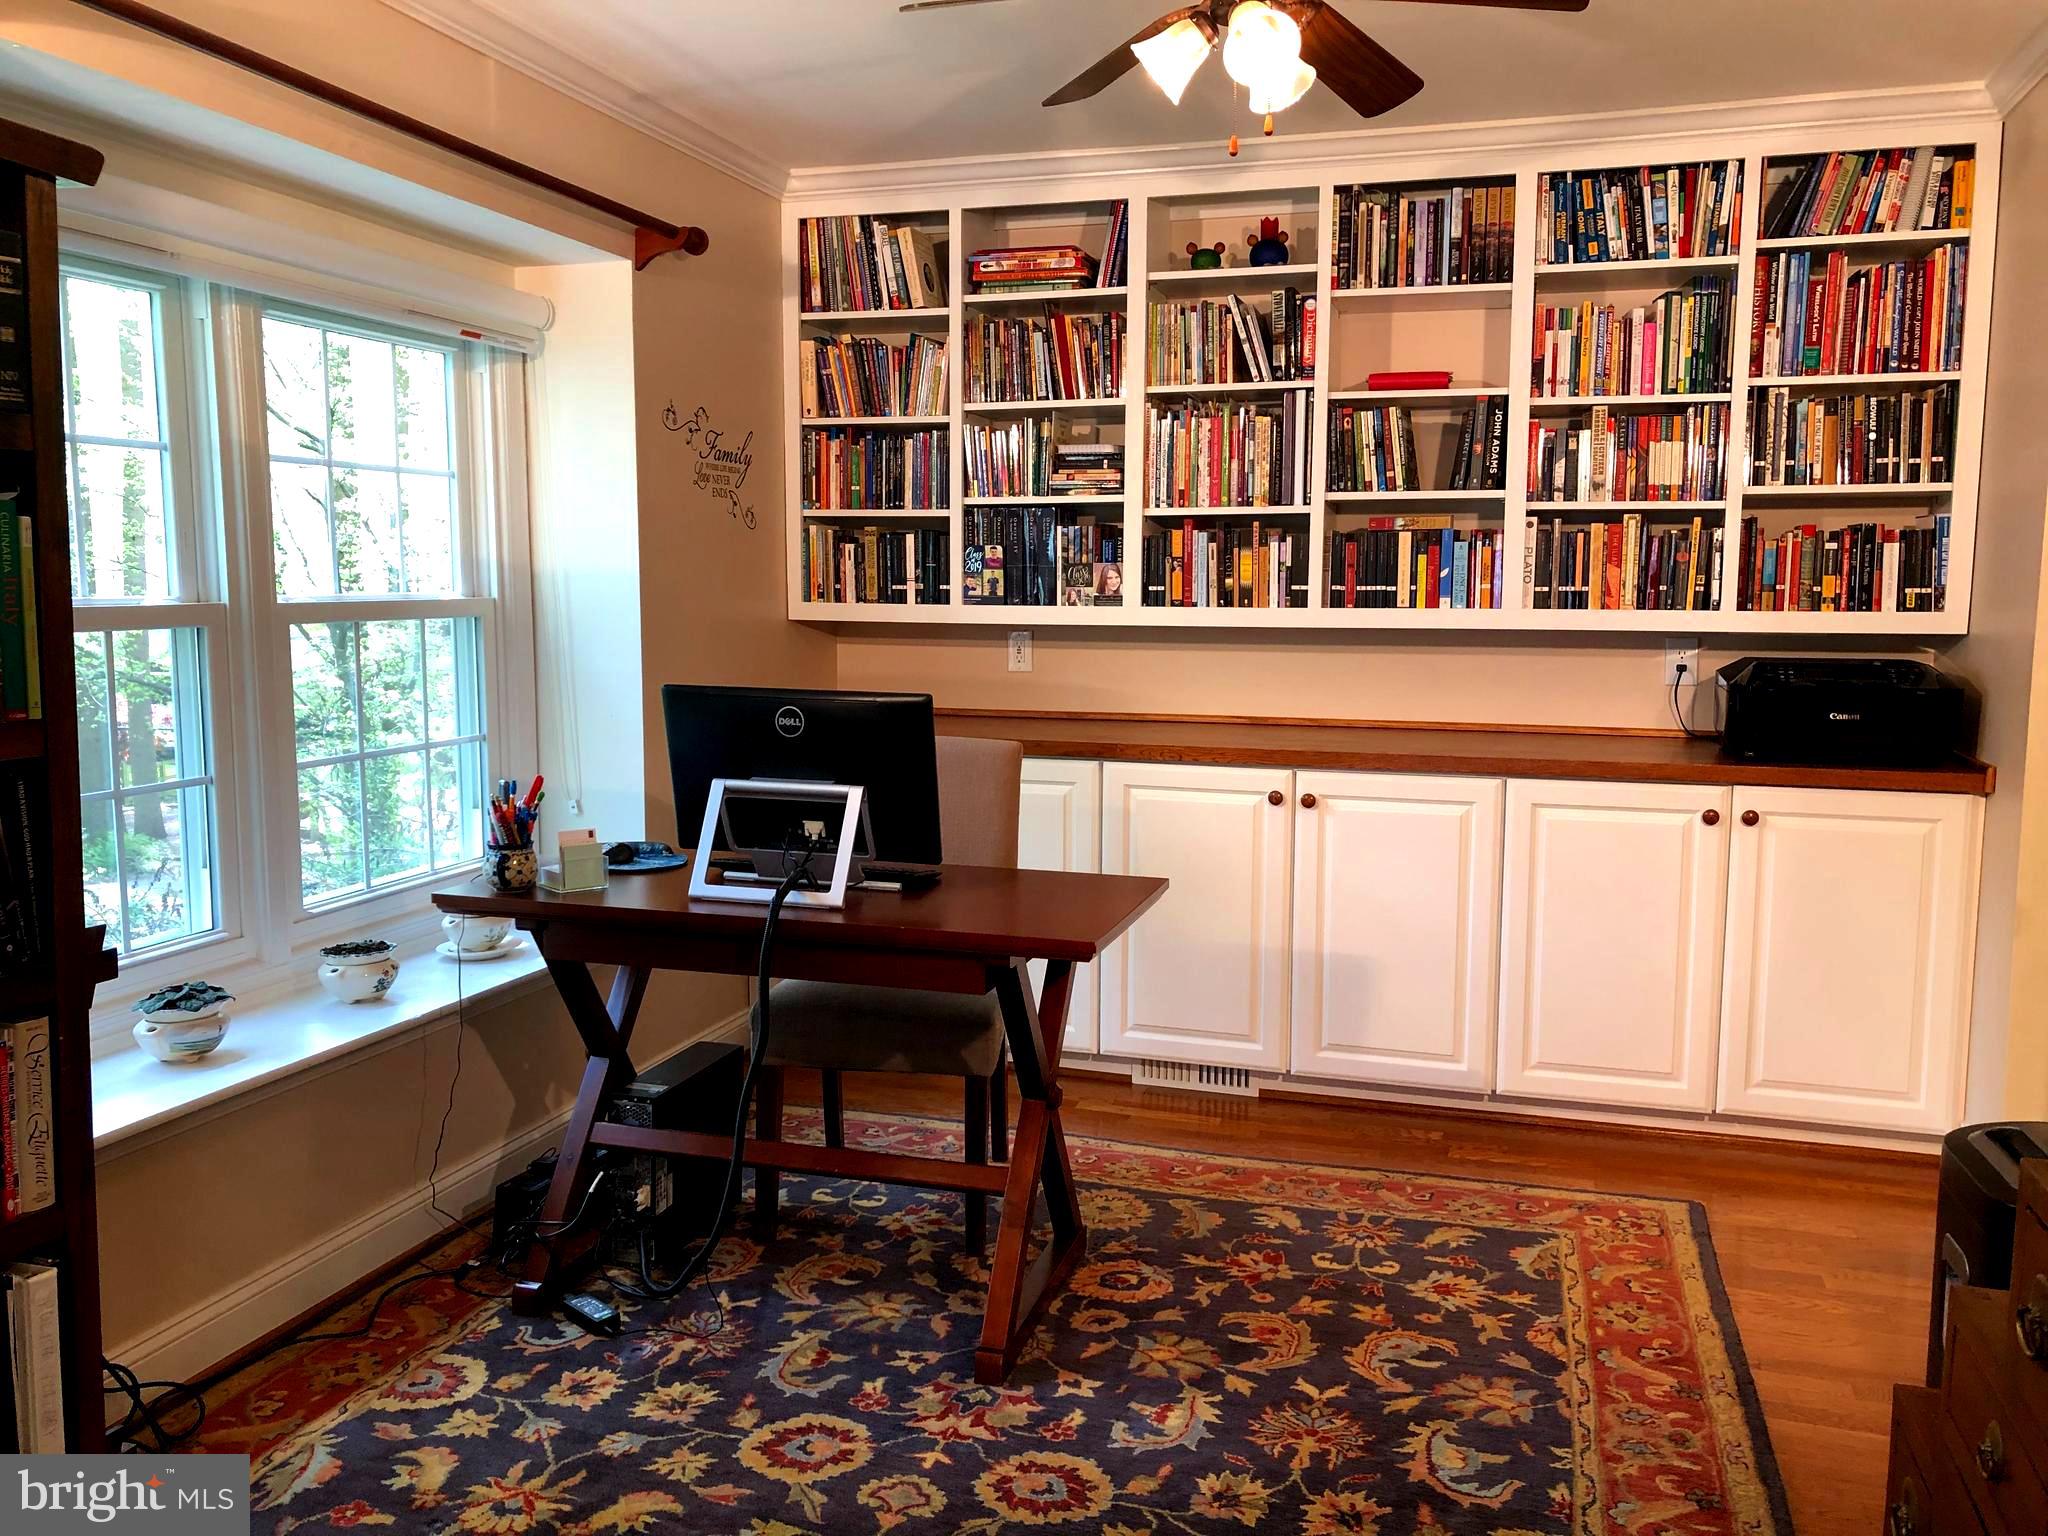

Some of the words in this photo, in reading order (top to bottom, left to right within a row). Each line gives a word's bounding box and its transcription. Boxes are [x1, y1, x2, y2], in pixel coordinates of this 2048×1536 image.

[1577, 211, 1585, 234] ROME
[1596, 211, 1606, 236] ITALY
[1634, 205, 1642, 226] ITALY
[1769, 261, 1779, 284] Window
[1915, 278, 1924, 301] WORLD
[1751, 287, 1764, 333] HISTORY
[1768, 303, 1776, 320] World
[1303, 313, 1316, 365] Dictionary
[1597, 313, 1606, 346] VOCABULARY
[1606, 312, 1614, 343] VOCABULARY
[1913, 320, 1921, 338] JOHN
[1596, 347, 1604, 374] CARTOONS
[1912, 339, 1920, 359] SMITH
[1493, 409, 1503, 436] JOHN
[1869, 397, 1877, 431] BEOWULF
[700, 430, 753, 489] Family
[1489, 439, 1500, 474] ADAMS
[964, 561, 982, 573] 2019
[1523, 546, 1534, 585] PLATO
[778, 717, 801, 726] DELL
[1829, 712, 1860, 720] Canon
